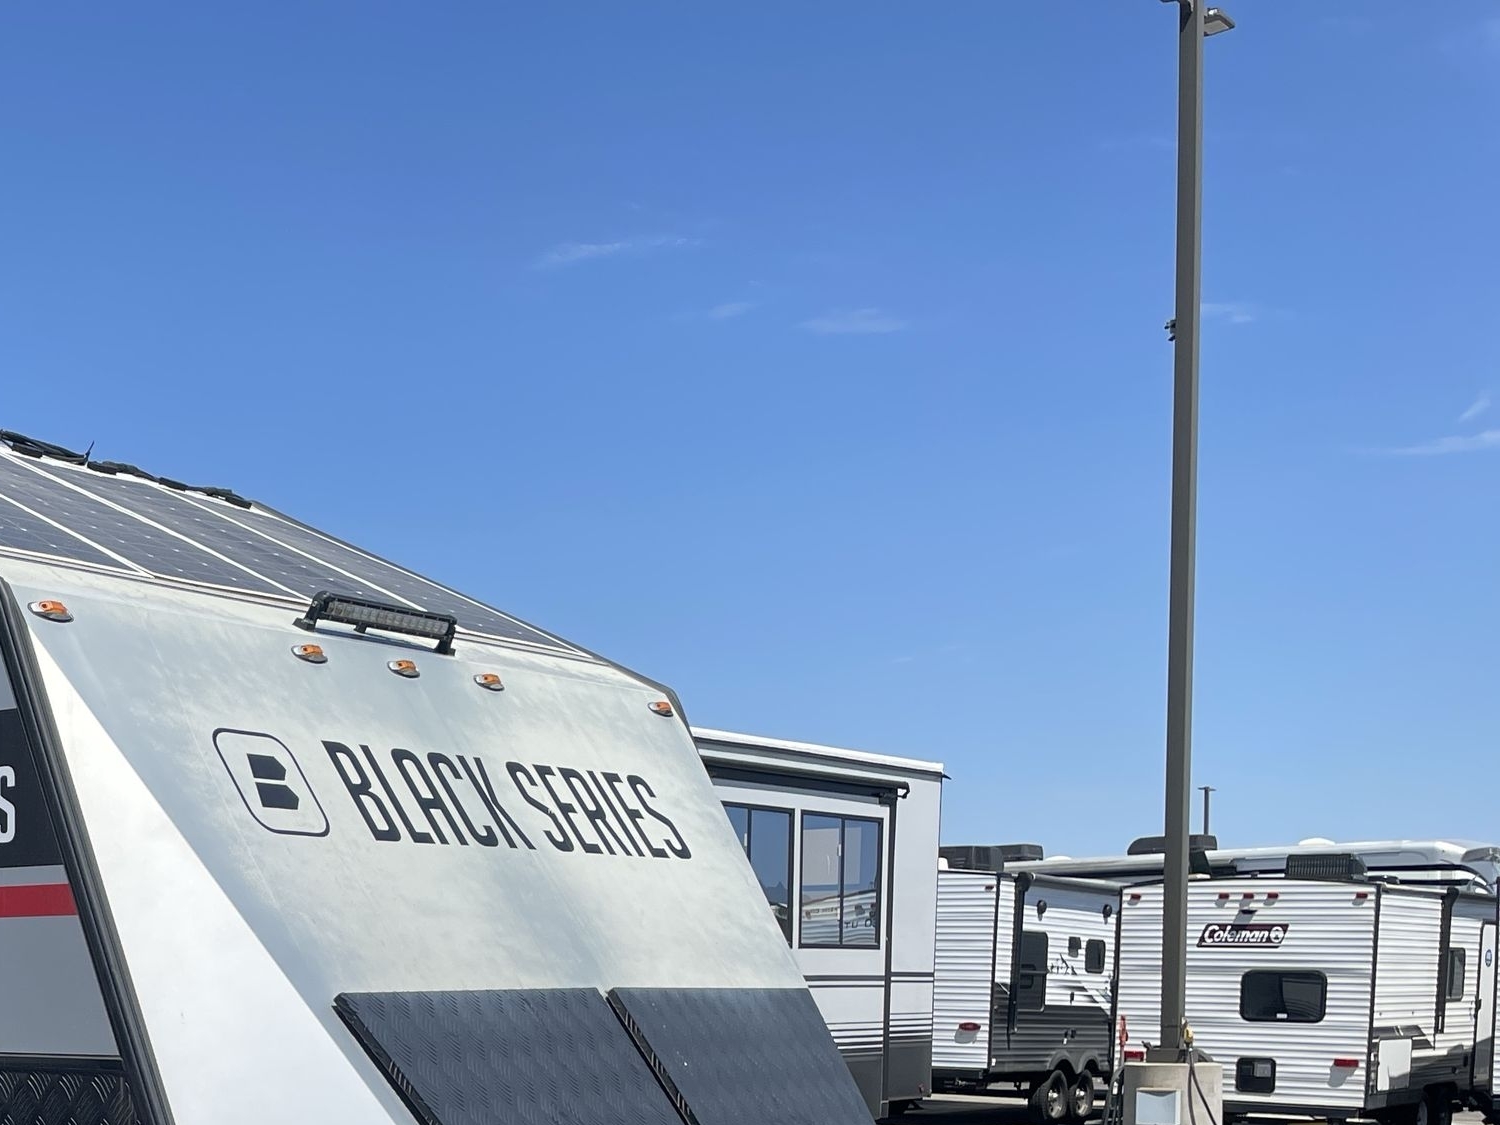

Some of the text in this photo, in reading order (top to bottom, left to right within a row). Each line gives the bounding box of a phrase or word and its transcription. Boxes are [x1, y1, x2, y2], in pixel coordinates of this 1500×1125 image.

[321, 740, 536, 850] BLACK
[506, 761, 691, 859] SERIES
[1204, 925, 1269, 943] Coleman
